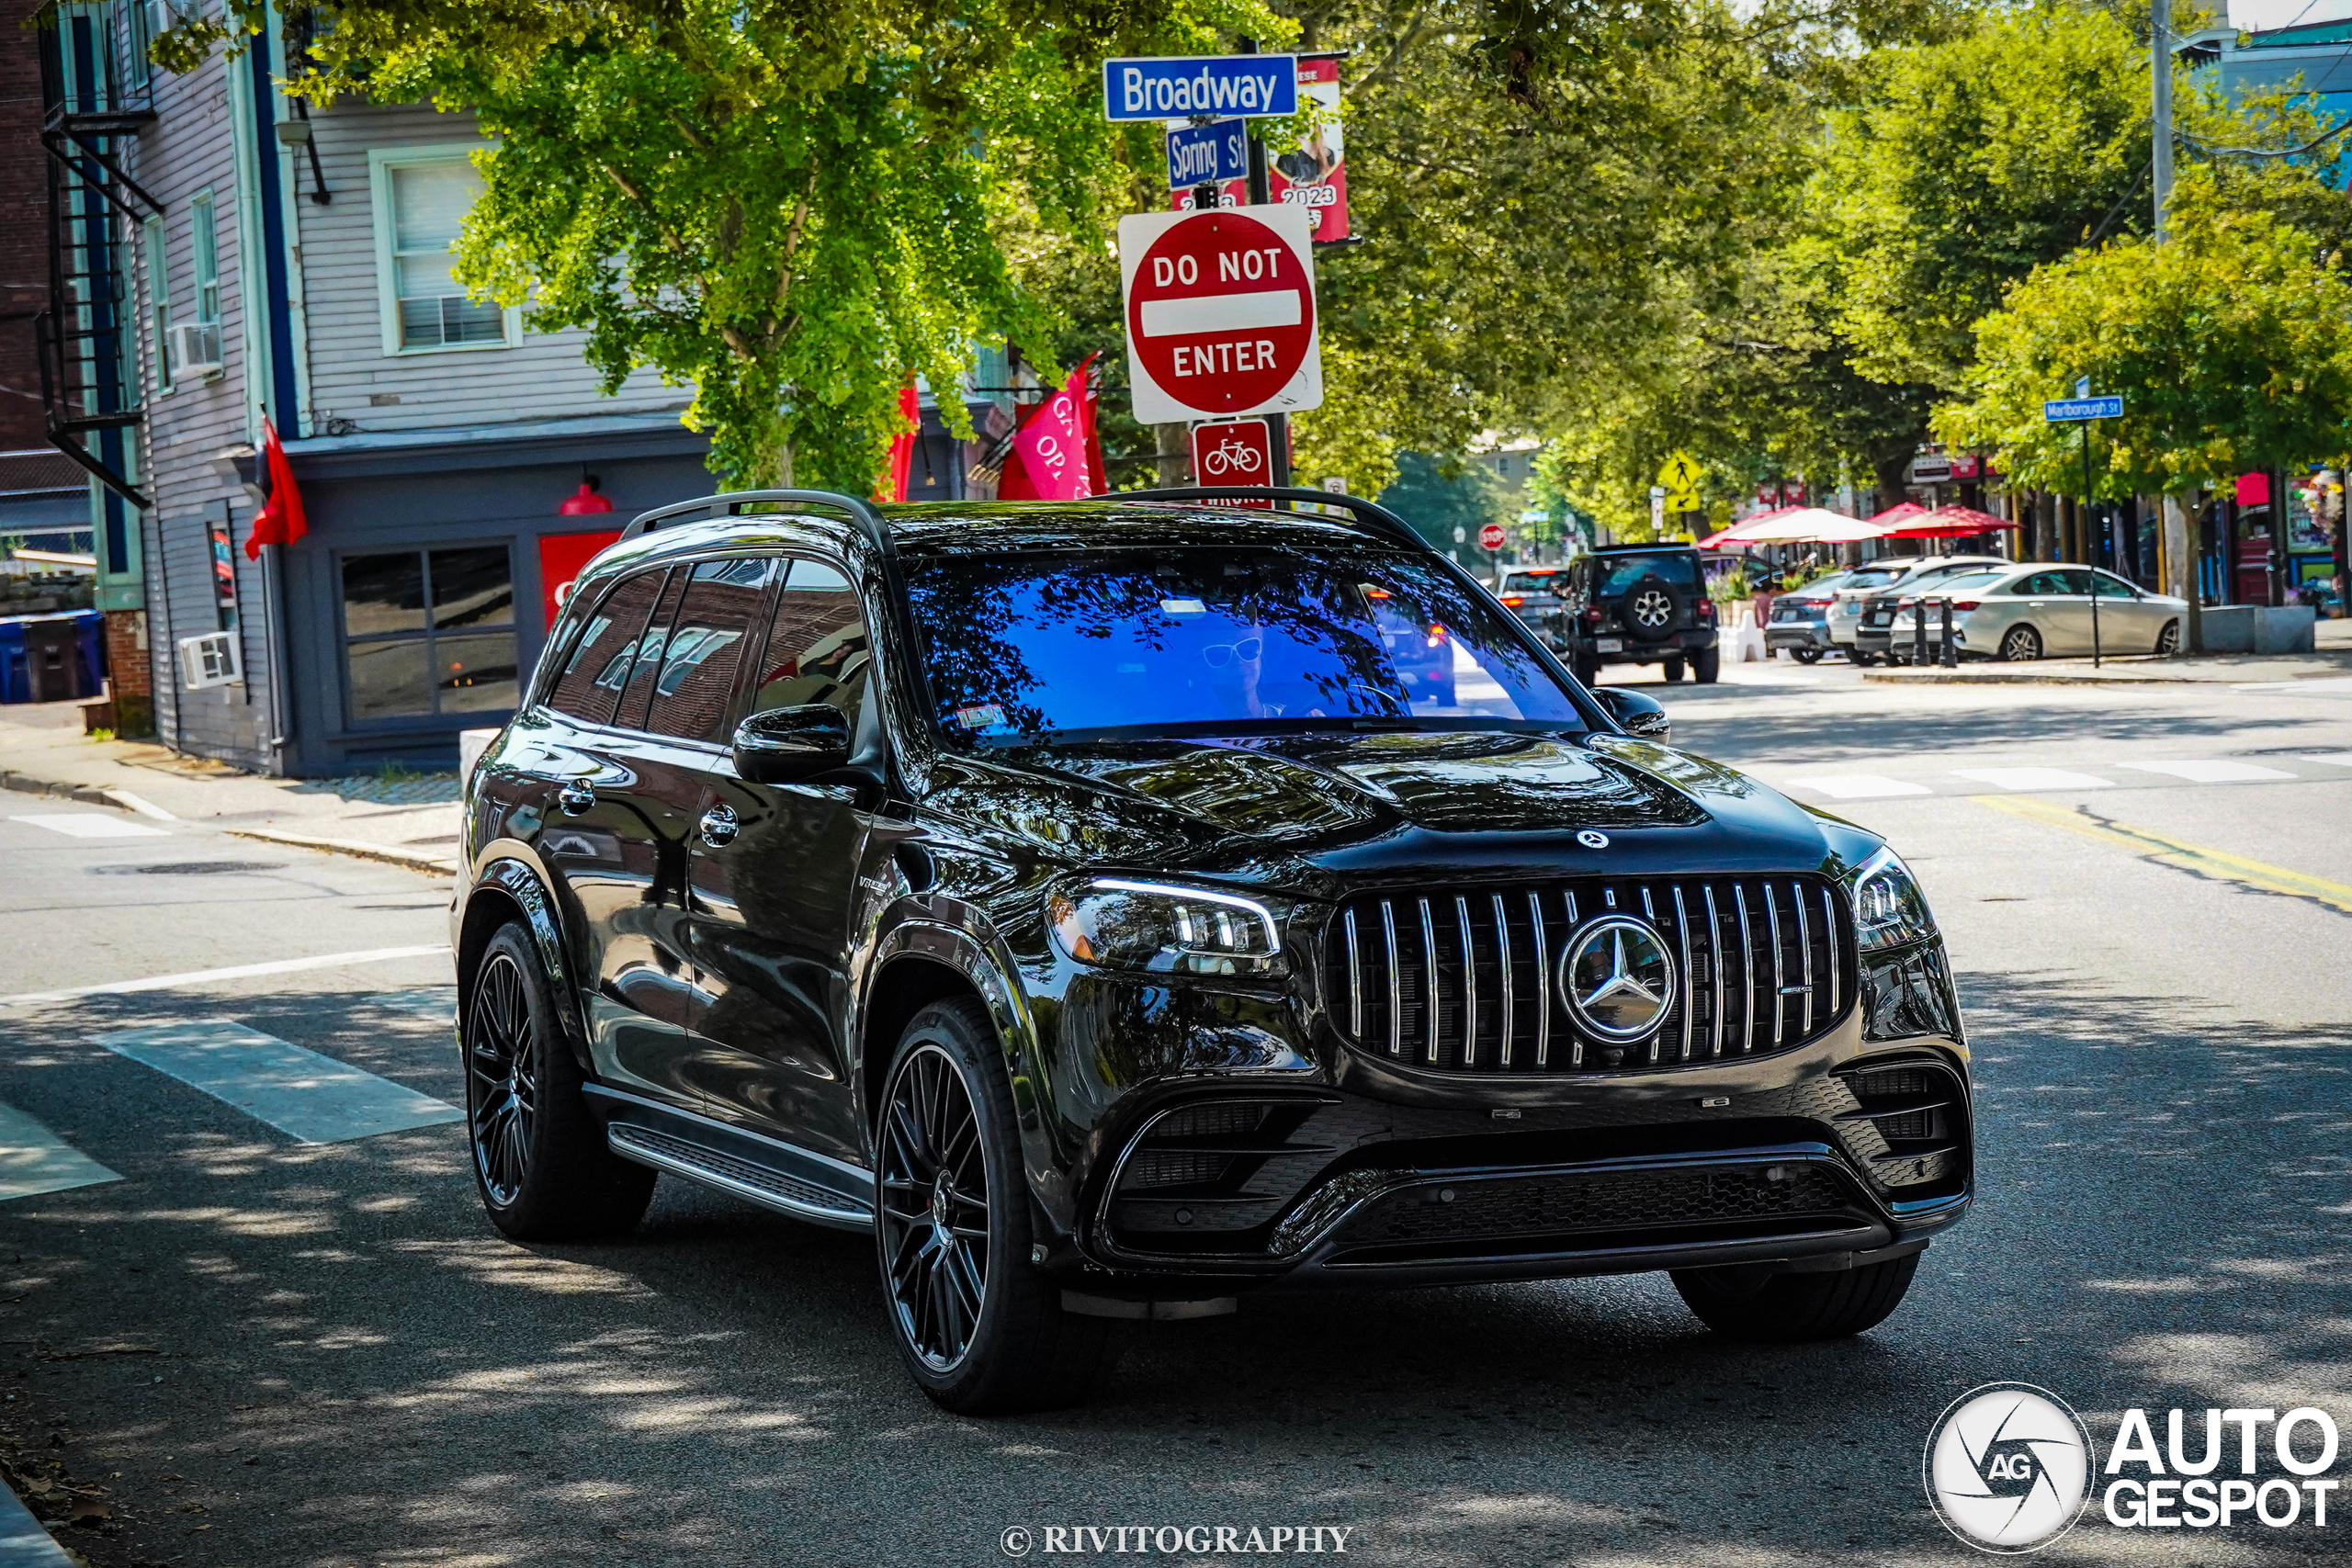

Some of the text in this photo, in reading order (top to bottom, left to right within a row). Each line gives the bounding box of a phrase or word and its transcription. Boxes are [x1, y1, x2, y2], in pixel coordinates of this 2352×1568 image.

[1123, 65, 1277, 112] Broadway
[1171, 134, 1245, 181] Spring St
[1282, 186, 1335, 206] 2023
[1153, 248, 1282, 288] DO NOT
[1173, 340, 1277, 378] ENTER
[2047, 401, 2119, 417] Marlborough St
[1482, 530, 1504, 543] STOP
